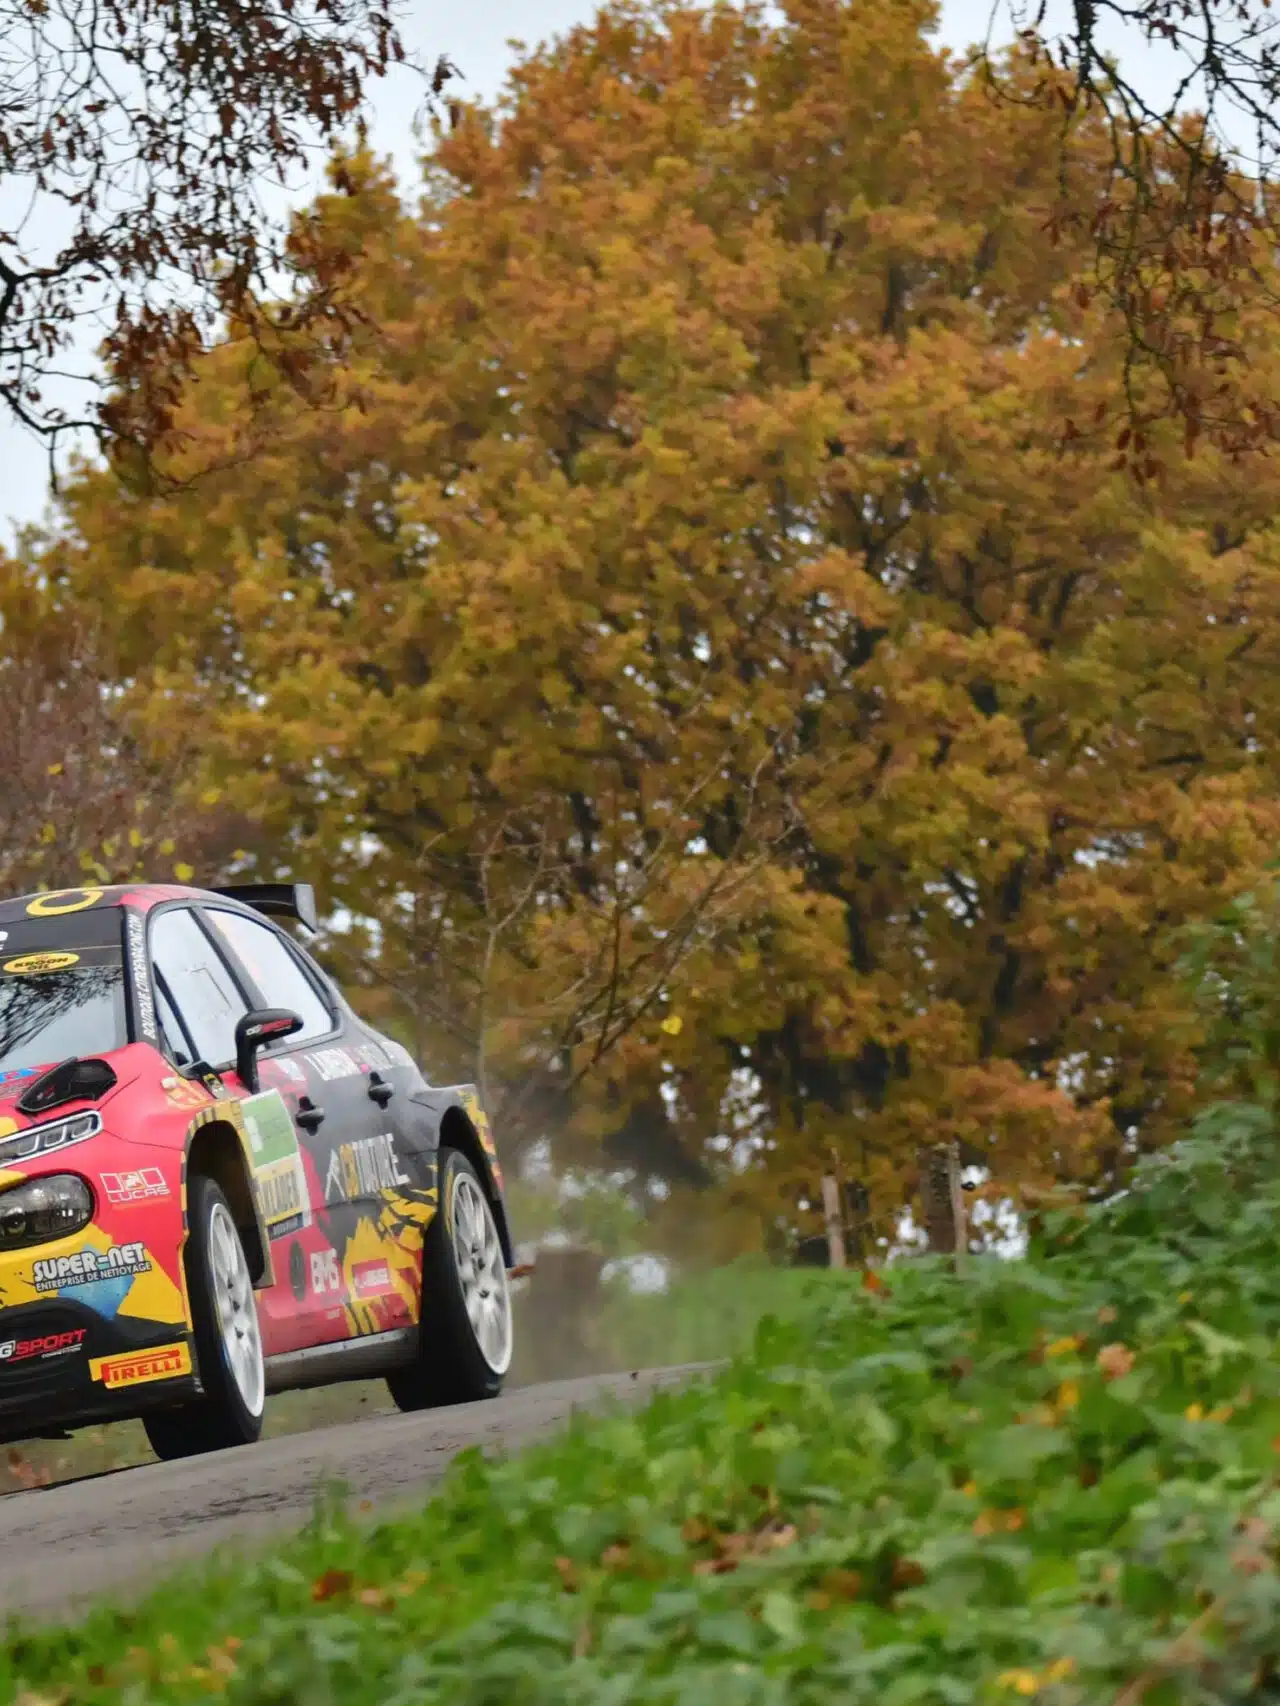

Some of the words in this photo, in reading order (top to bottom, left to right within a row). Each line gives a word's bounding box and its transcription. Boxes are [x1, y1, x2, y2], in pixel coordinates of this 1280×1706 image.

[36, 1275, 85, 1292] ENTREPRISE
[87, 1272, 100, 1283] DE
[100, 1262, 153, 1280] NETTOYAGE
[100, 1350, 184, 1384] PIRELLI
